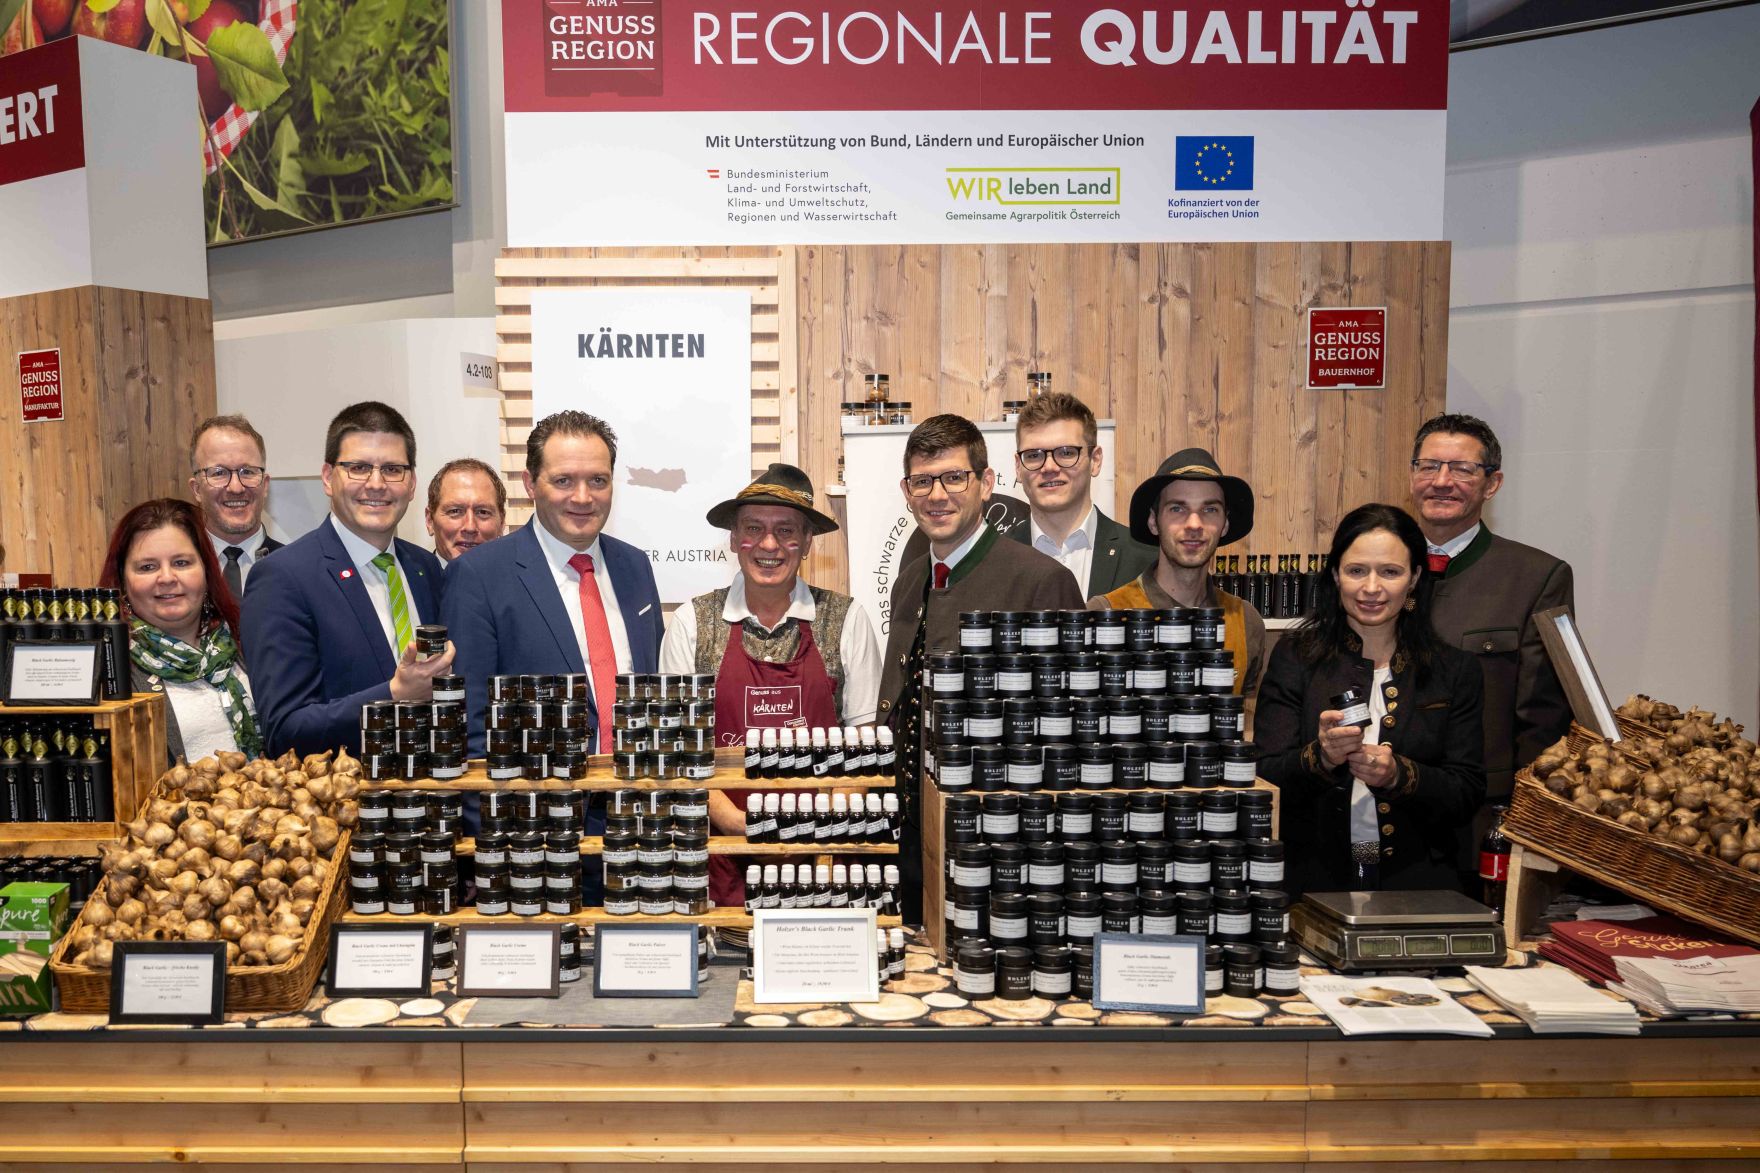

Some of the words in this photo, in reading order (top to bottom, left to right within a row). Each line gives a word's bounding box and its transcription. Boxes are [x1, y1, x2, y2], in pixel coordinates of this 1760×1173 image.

[549, 15, 656, 35] GENUSS
[693, 10, 1052, 66] REGIONALE
[1079, 0, 1419, 68] QUALITÄT
[551, 40, 655, 60] REGION
[705, 134, 731, 149] Mit
[734, 134, 836, 151] Unterstützung
[839, 137, 866, 148] von
[870, 133, 911, 150] Bund,
[915, 133, 973, 147] Ländern
[976, 133, 1004, 147] und
[1008, 133, 1099, 151] Europäischer
[1102, 133, 1145, 147] Union
[727, 168, 829, 179] Bundesministerium
[727, 182, 758, 194] Land-
[761, 182, 781, 193] und
[785, 182, 871, 195] Forstwirtschaft,
[946, 177, 1002, 201] WIR
[1008, 177, 1060, 195] leben
[1066, 176, 1111, 195] Land
[727, 197, 762, 208] Klima-
[765, 197, 785, 208] und
[789, 196, 868, 209] Umweltschutz,
[1168, 198, 1224, 208] Kofinanziert
[1225, 200, 1243, 208] von
[1244, 198, 1260, 208] der
[727, 212, 776, 225] Regionen
[780, 211, 800, 222] und
[803, 210, 897, 222] Wasserwirtschaft
[945, 211, 1007, 221] Gemeinsame
[1010, 210, 1067, 223] Agrarpolitik
[1069, 208, 1121, 221] Österreich
[1168, 209, 1229, 220] Europäischen
[1231, 209, 1260, 219] Union
[1339, 320, 1359, 328] AMA
[577, 326, 706, 359] KÄRNTEN
[1314, 332, 1381, 345] GENUSS
[1314, 347, 1380, 361] REGION
[21, 371, 58, 385] GENUSS
[466, 362, 493, 380] 4.2-103
[1318, 368, 1375, 376] BAUERNHOF
[22, 384, 59, 398] REGION
[24, 403, 59, 411] MANUFAKTUR
[665, 549, 728, 562] AUSTRIA
[873, 516, 909, 594] schwarze
[881, 598, 891, 635] Das
[0, 908, 40, 929] pure
